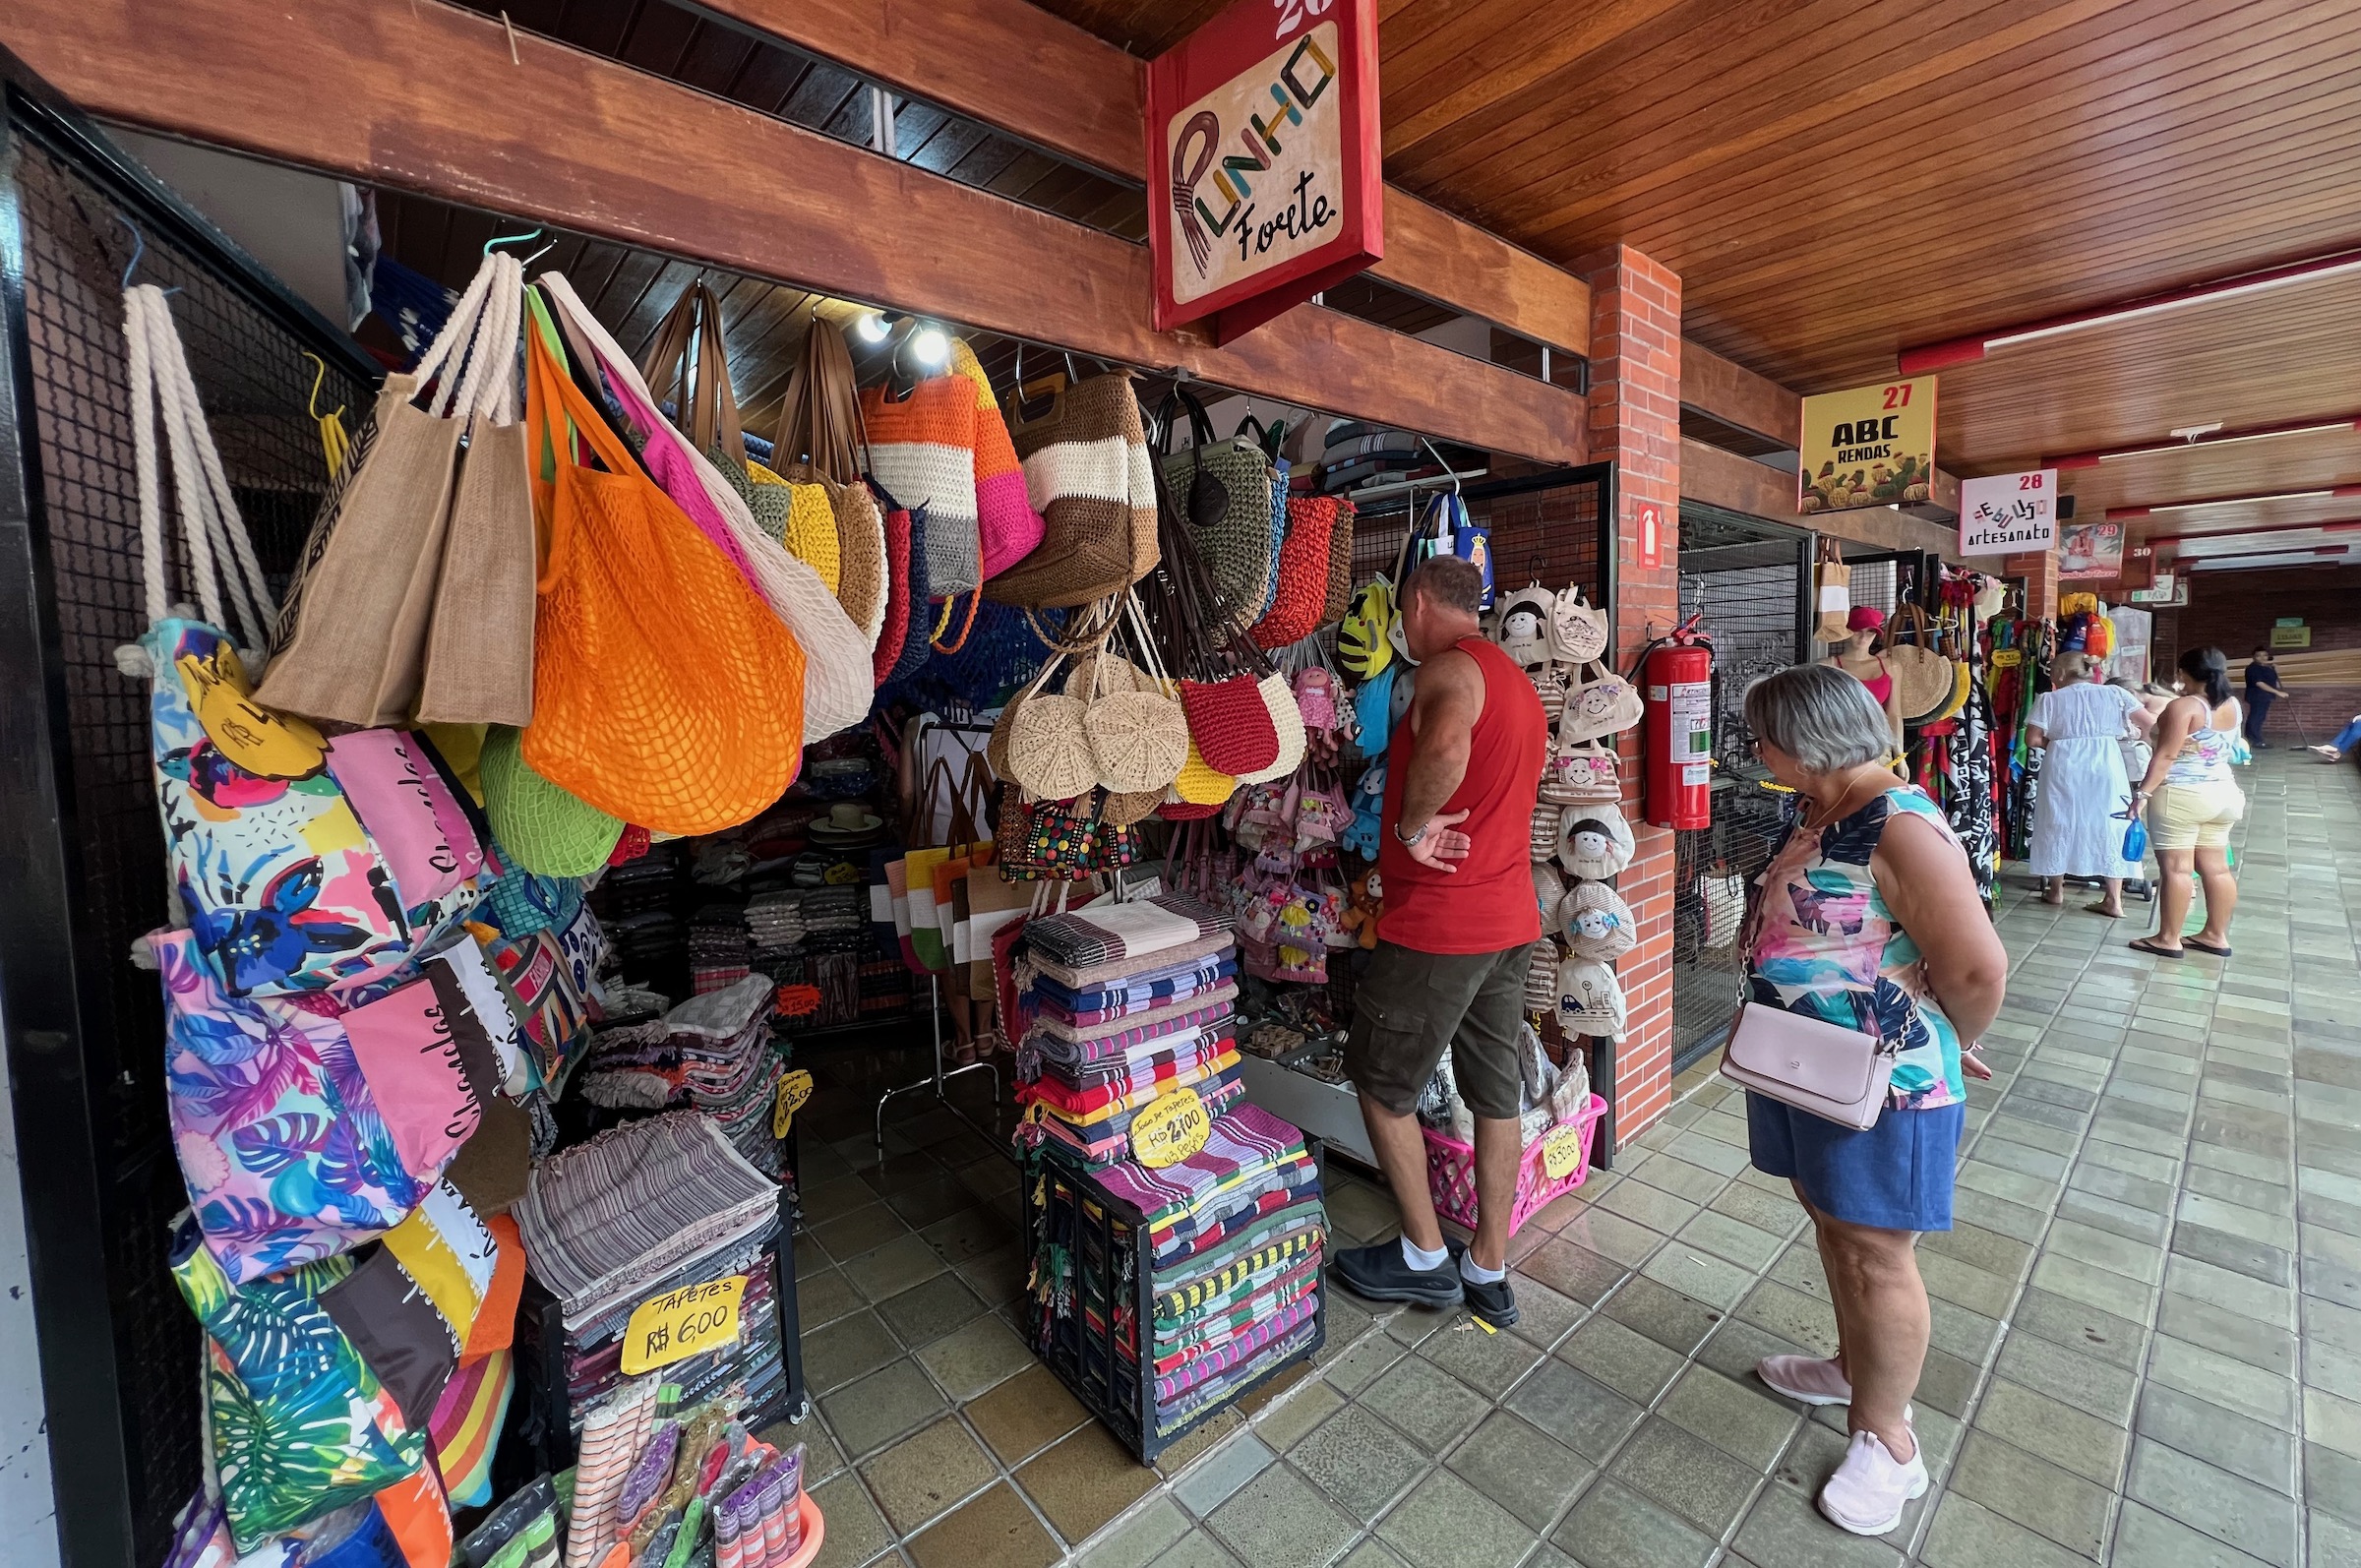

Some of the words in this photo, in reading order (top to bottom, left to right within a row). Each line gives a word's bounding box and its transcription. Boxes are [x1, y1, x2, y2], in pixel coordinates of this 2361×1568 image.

[1274, 0, 1333, 40] 2
[1234, 170, 1337, 261] Forte
[1883, 384, 1912, 410] 27
[1832, 415, 1900, 448] ABC
[1838, 444, 1891, 463] RENDAS
[2020, 474, 2042, 490] 28
[2098, 524, 2118, 536] 29
[2133, 547, 2151, 557] 30
[646, 1322, 670, 1359] R$
[677, 1305, 728, 1345] 6,00
